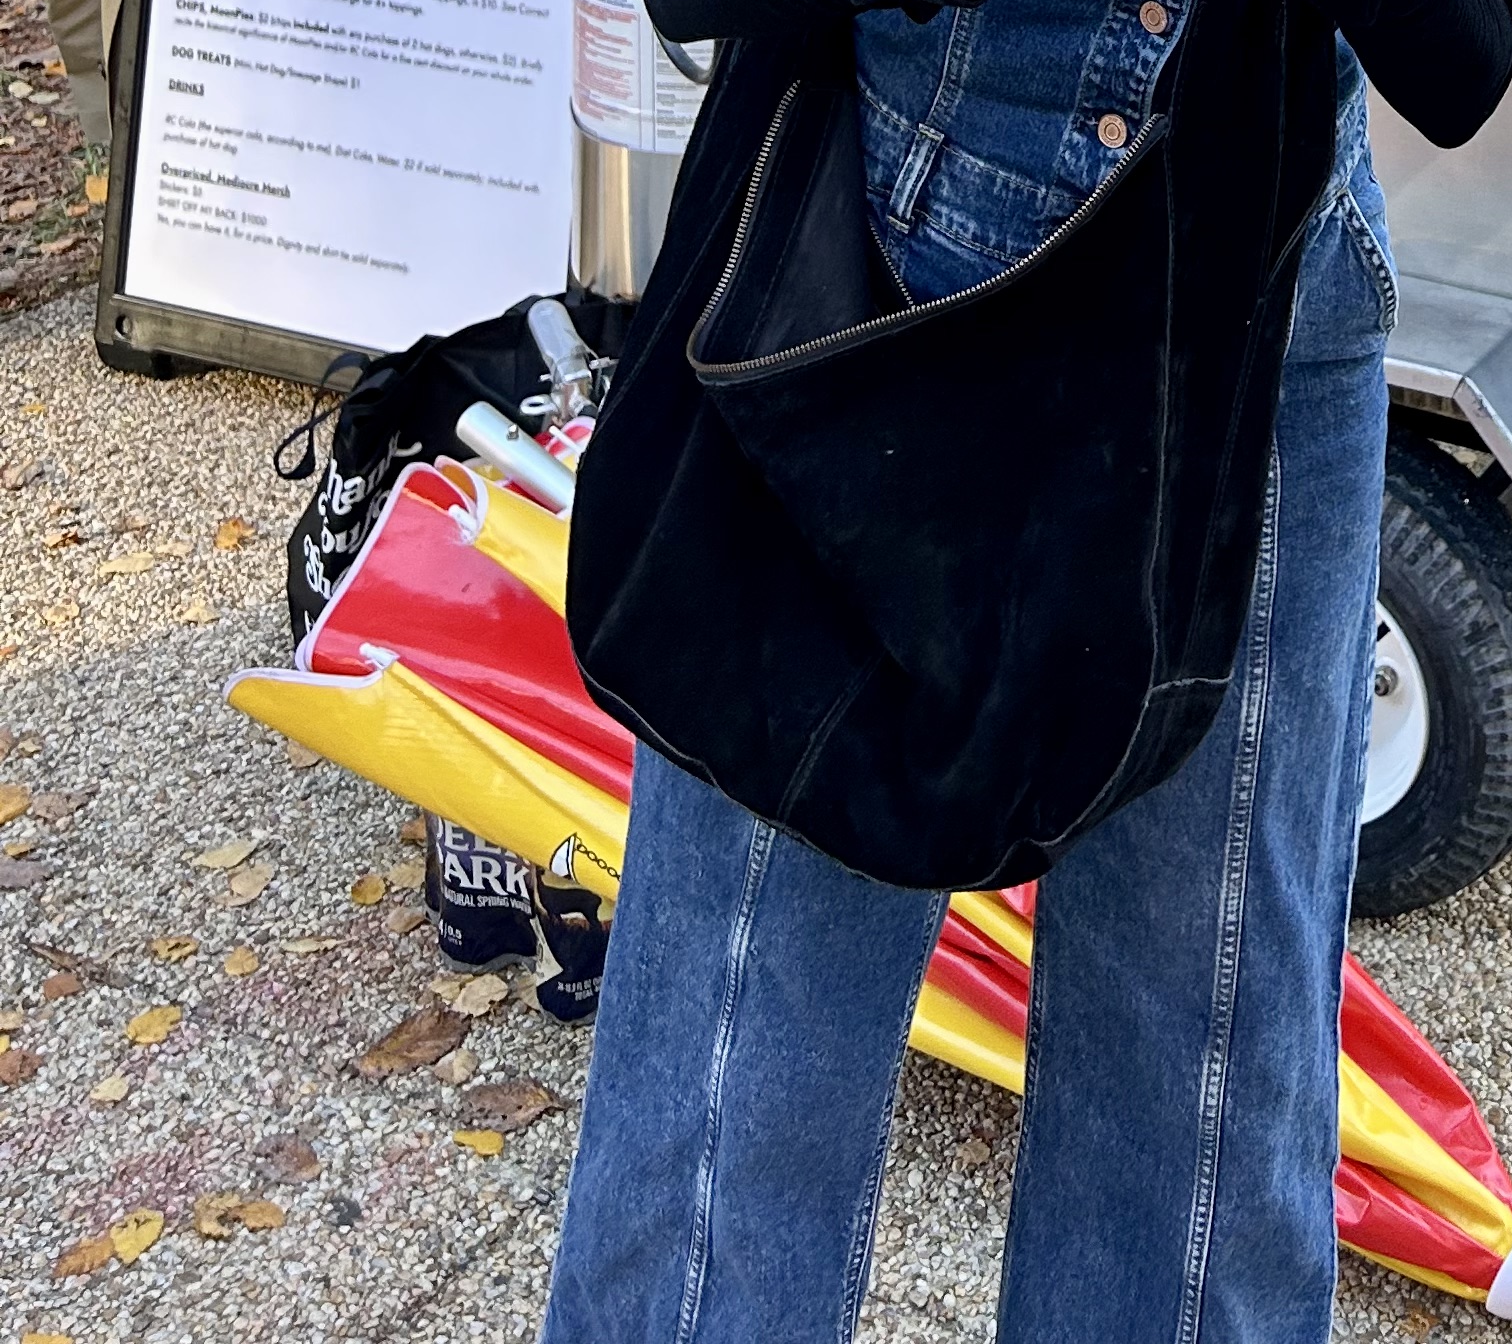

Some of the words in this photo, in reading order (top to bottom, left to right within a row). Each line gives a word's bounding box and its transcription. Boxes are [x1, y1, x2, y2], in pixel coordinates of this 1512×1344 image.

[172, 45, 194, 59] DOG
[197, 49, 232, 67] TREATS
[168, 78, 204, 96] DRINKS
